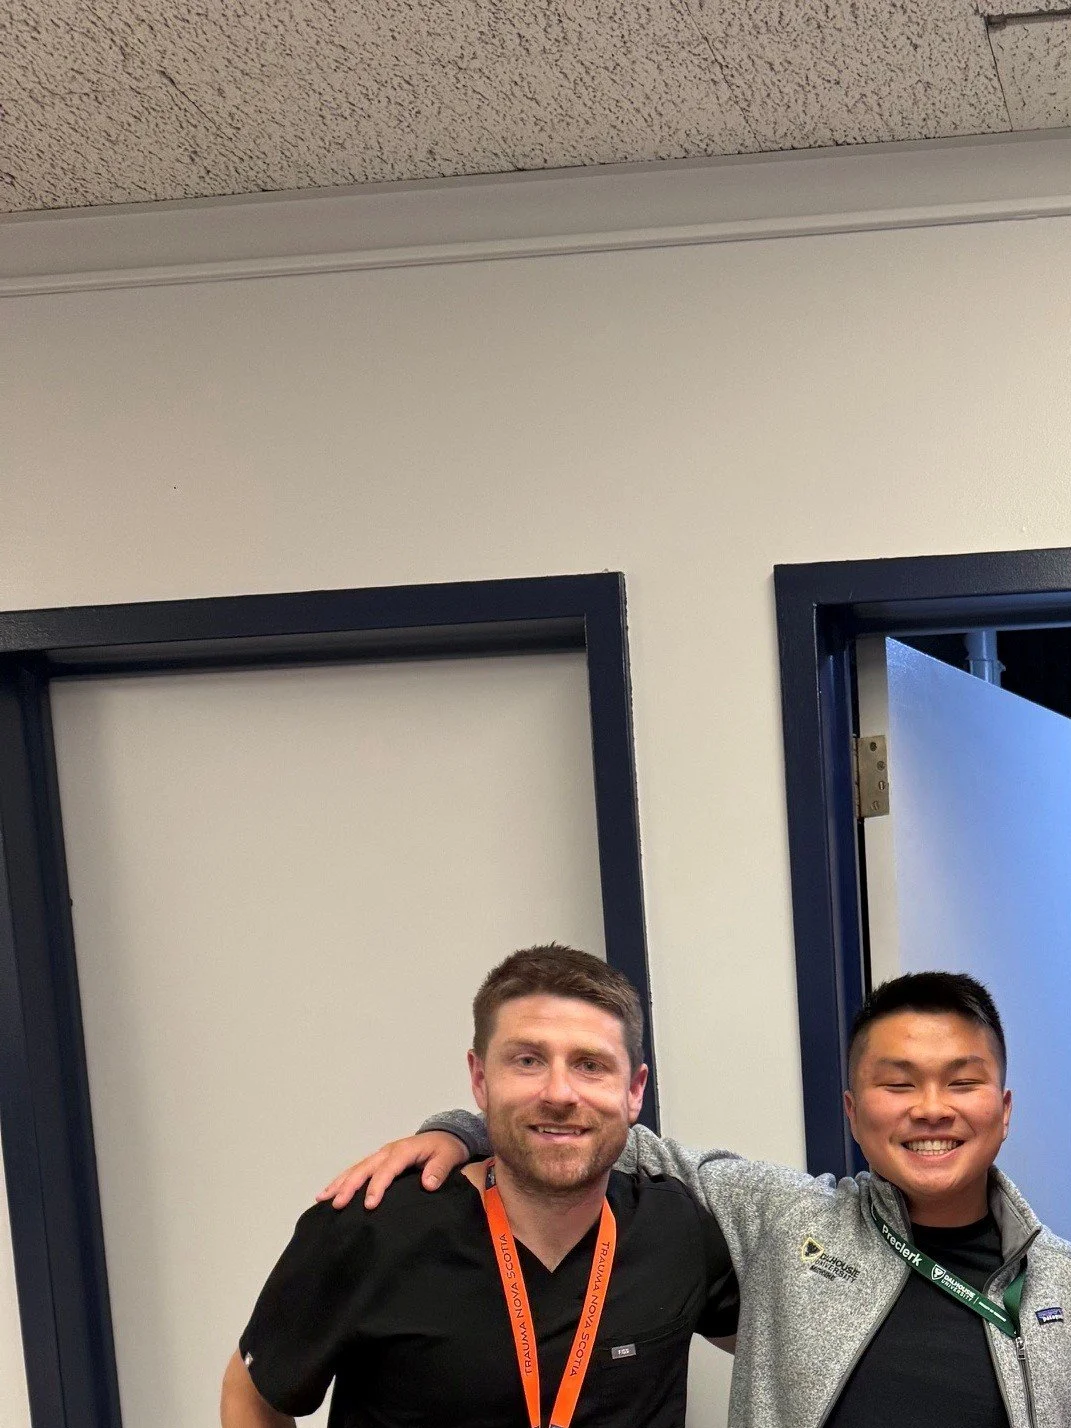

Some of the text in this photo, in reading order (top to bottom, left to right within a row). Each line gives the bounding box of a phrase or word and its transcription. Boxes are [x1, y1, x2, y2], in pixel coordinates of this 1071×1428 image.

[882, 1224, 923, 1267] Preclerk
[940, 1279, 973, 1301] UNIVERSITY
[500, 1233, 533, 1376] TRAUMA NOVA SCOTIA
[570, 1241, 610, 1377] TRAUMA NOVA SCOTIA
